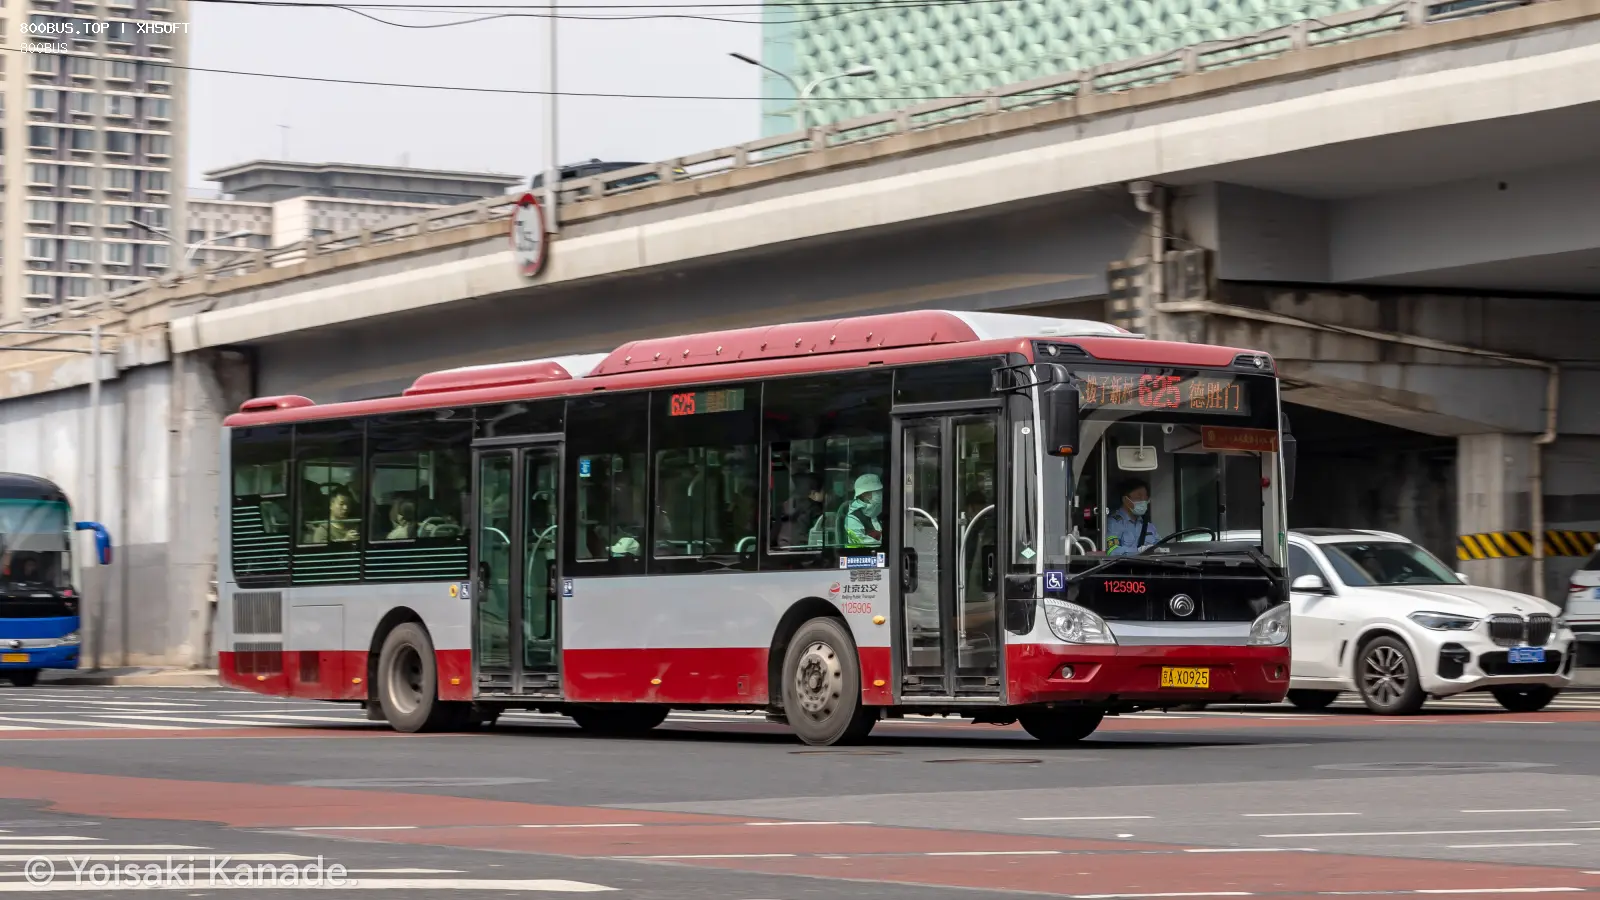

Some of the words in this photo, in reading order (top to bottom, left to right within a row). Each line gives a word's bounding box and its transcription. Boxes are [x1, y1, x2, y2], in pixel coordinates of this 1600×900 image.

[1138, 374, 1181, 409] 625
[1189, 380, 1240, 411] 德胜门
[671, 392, 696, 416] 625
[843, 584, 878, 593] 北京公交
[1104, 580, 1146, 593] 1125905
[842, 602, 871, 613] 1125905
